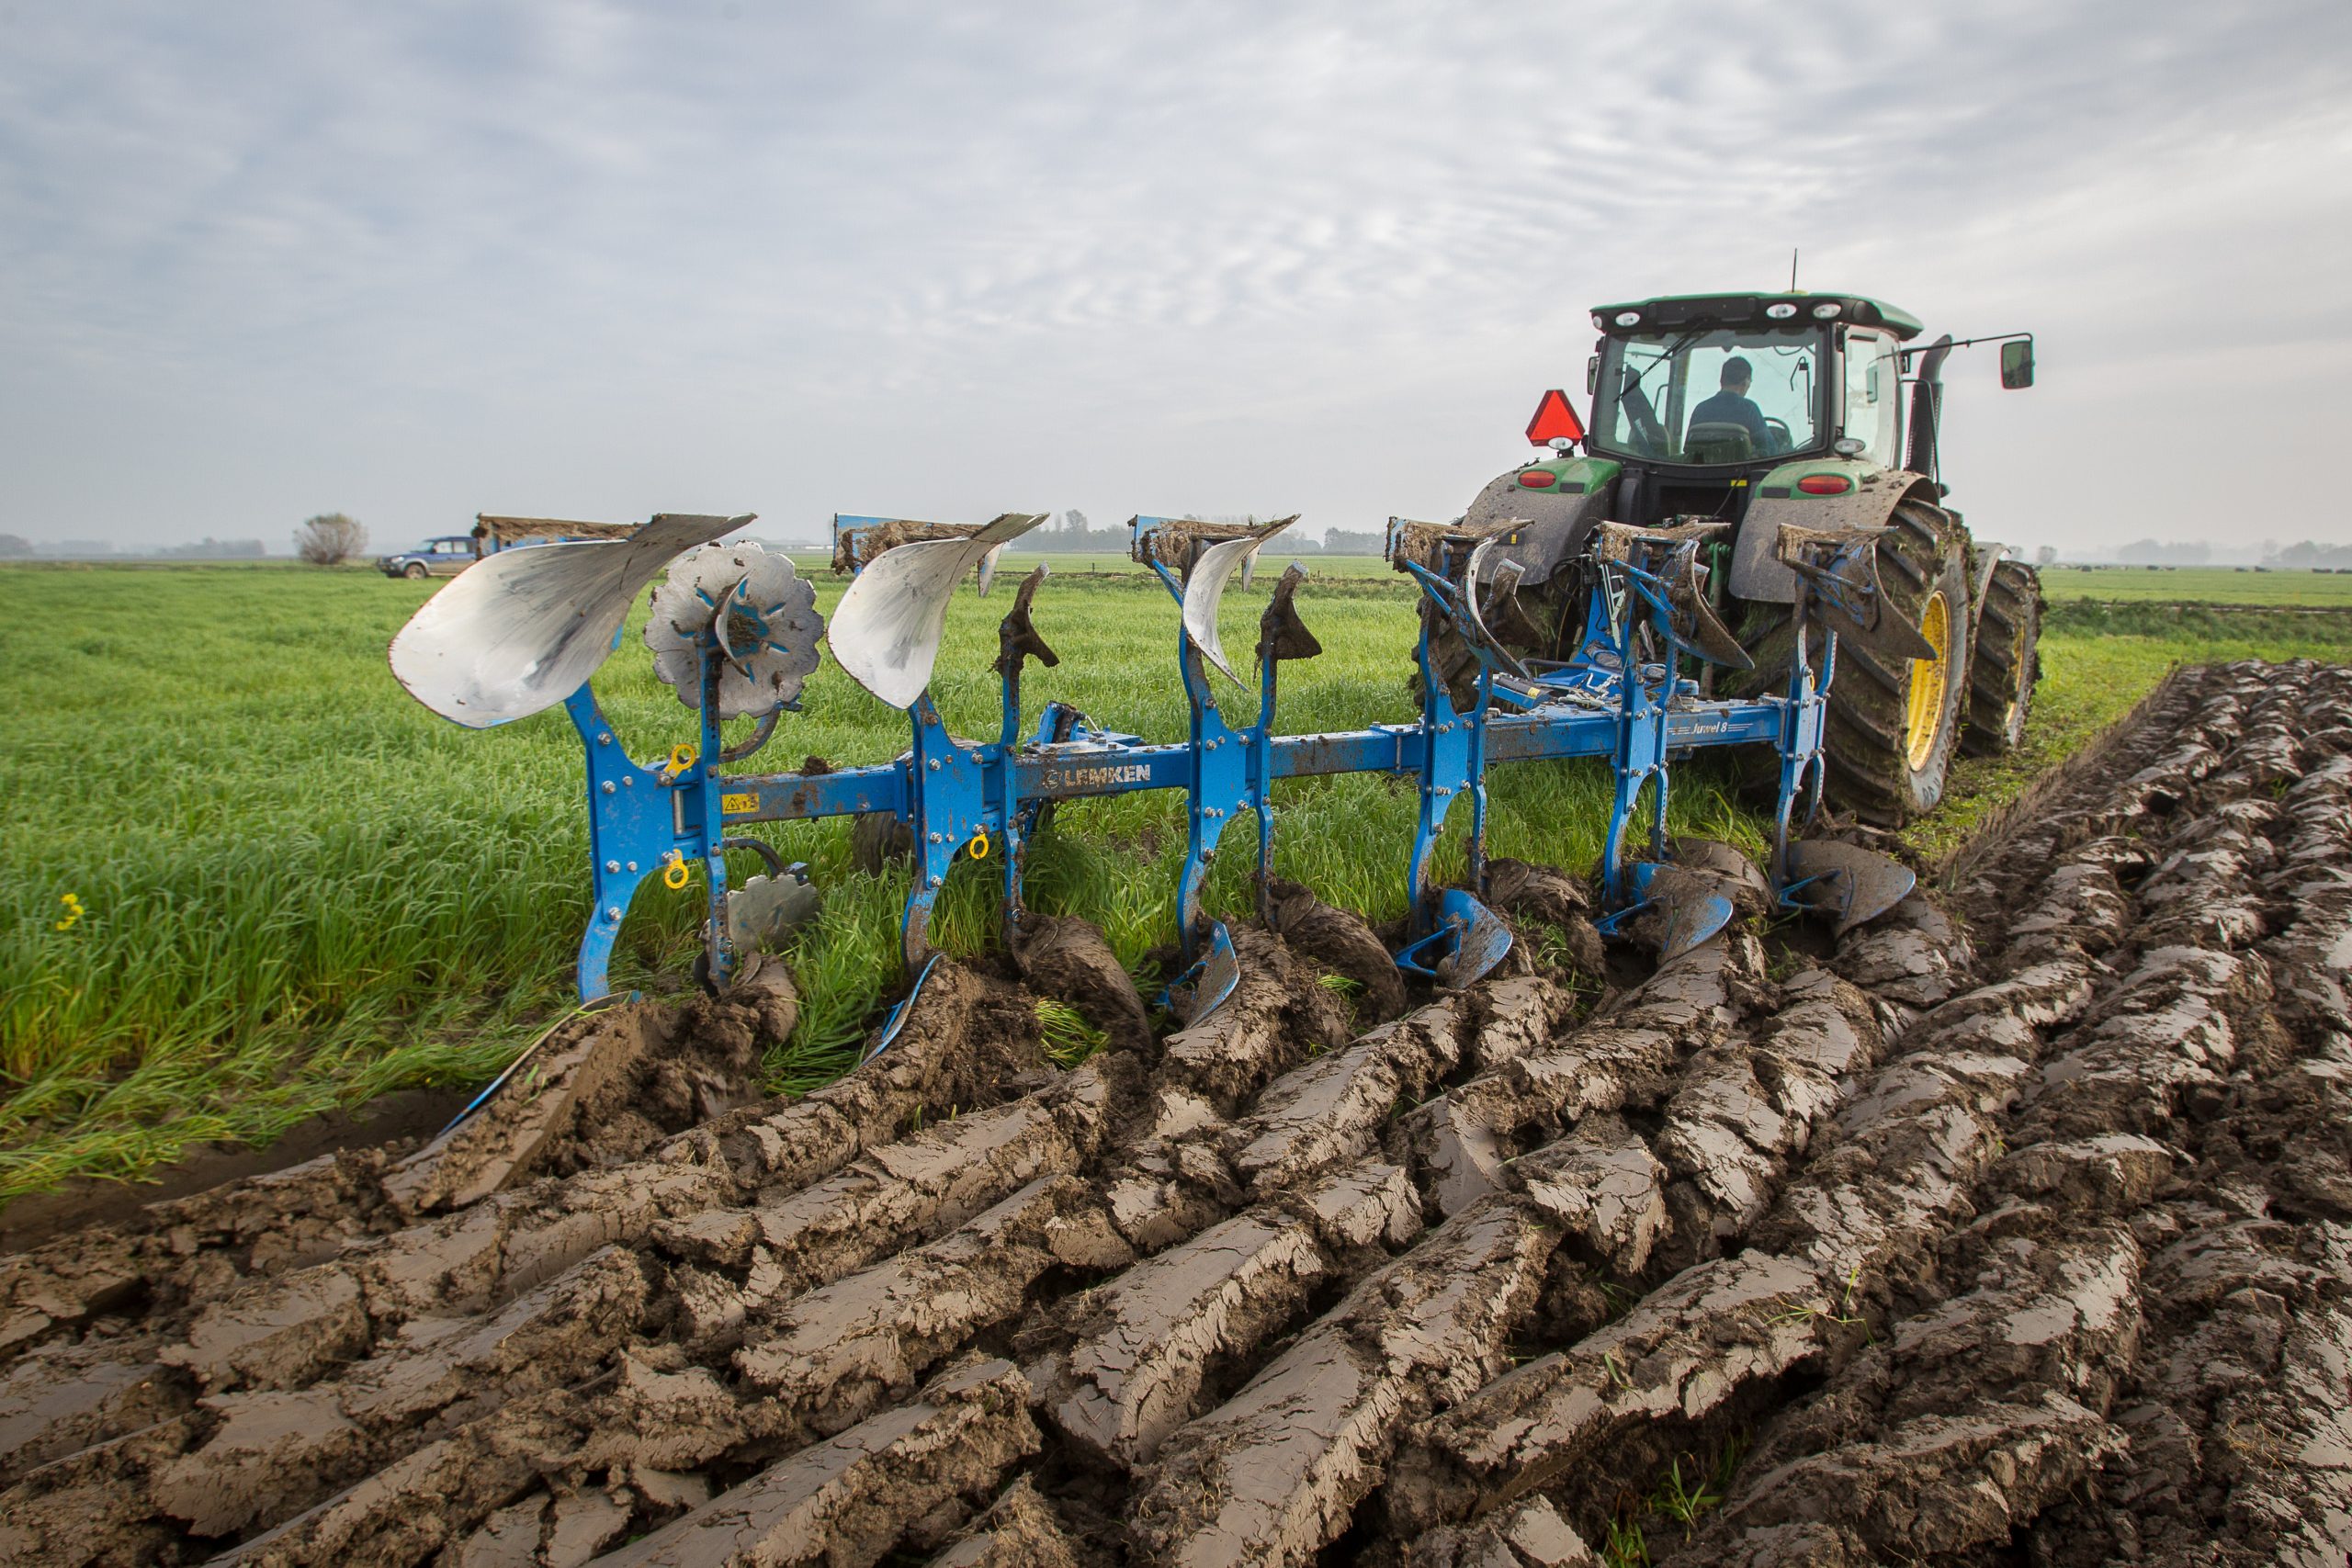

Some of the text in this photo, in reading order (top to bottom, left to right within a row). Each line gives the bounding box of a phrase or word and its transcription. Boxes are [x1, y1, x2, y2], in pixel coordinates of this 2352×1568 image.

[1691, 721, 1728, 734] Juwel 8
[1064, 764, 1151, 787] LEMKEN
